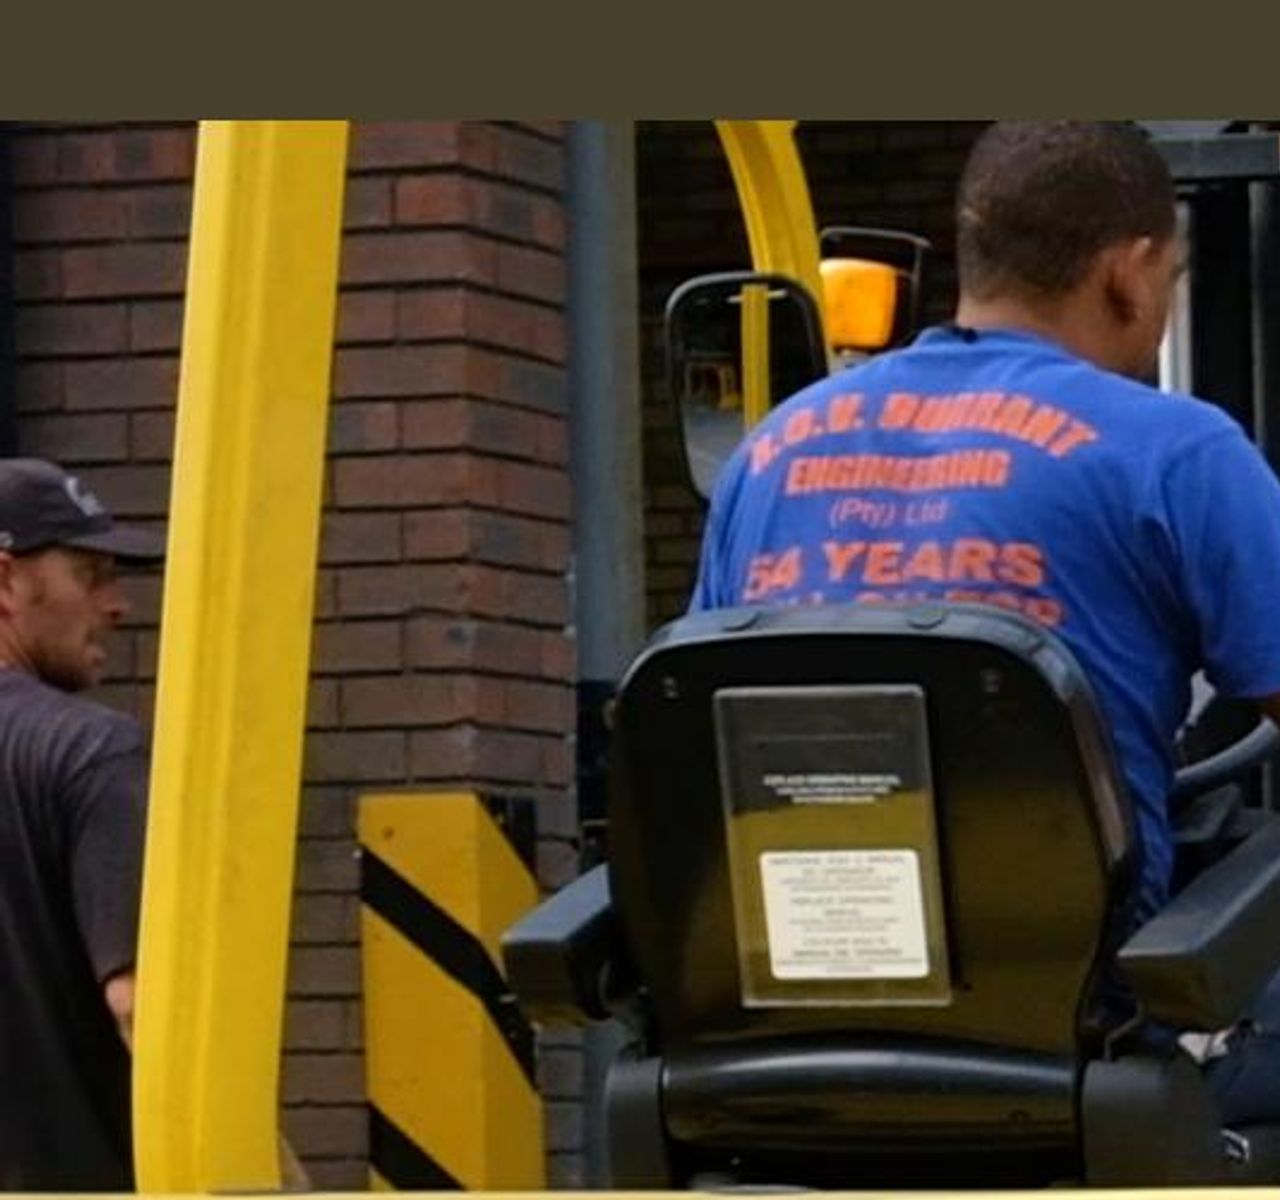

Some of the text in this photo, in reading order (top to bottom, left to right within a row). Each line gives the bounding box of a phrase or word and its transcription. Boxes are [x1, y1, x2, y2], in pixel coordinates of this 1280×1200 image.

[787, 450, 1010, 495] ENGINEERING
[830, 498, 948, 529] (Pty) Ltd
[744, 538, 1045, 601] 54 YEARS
